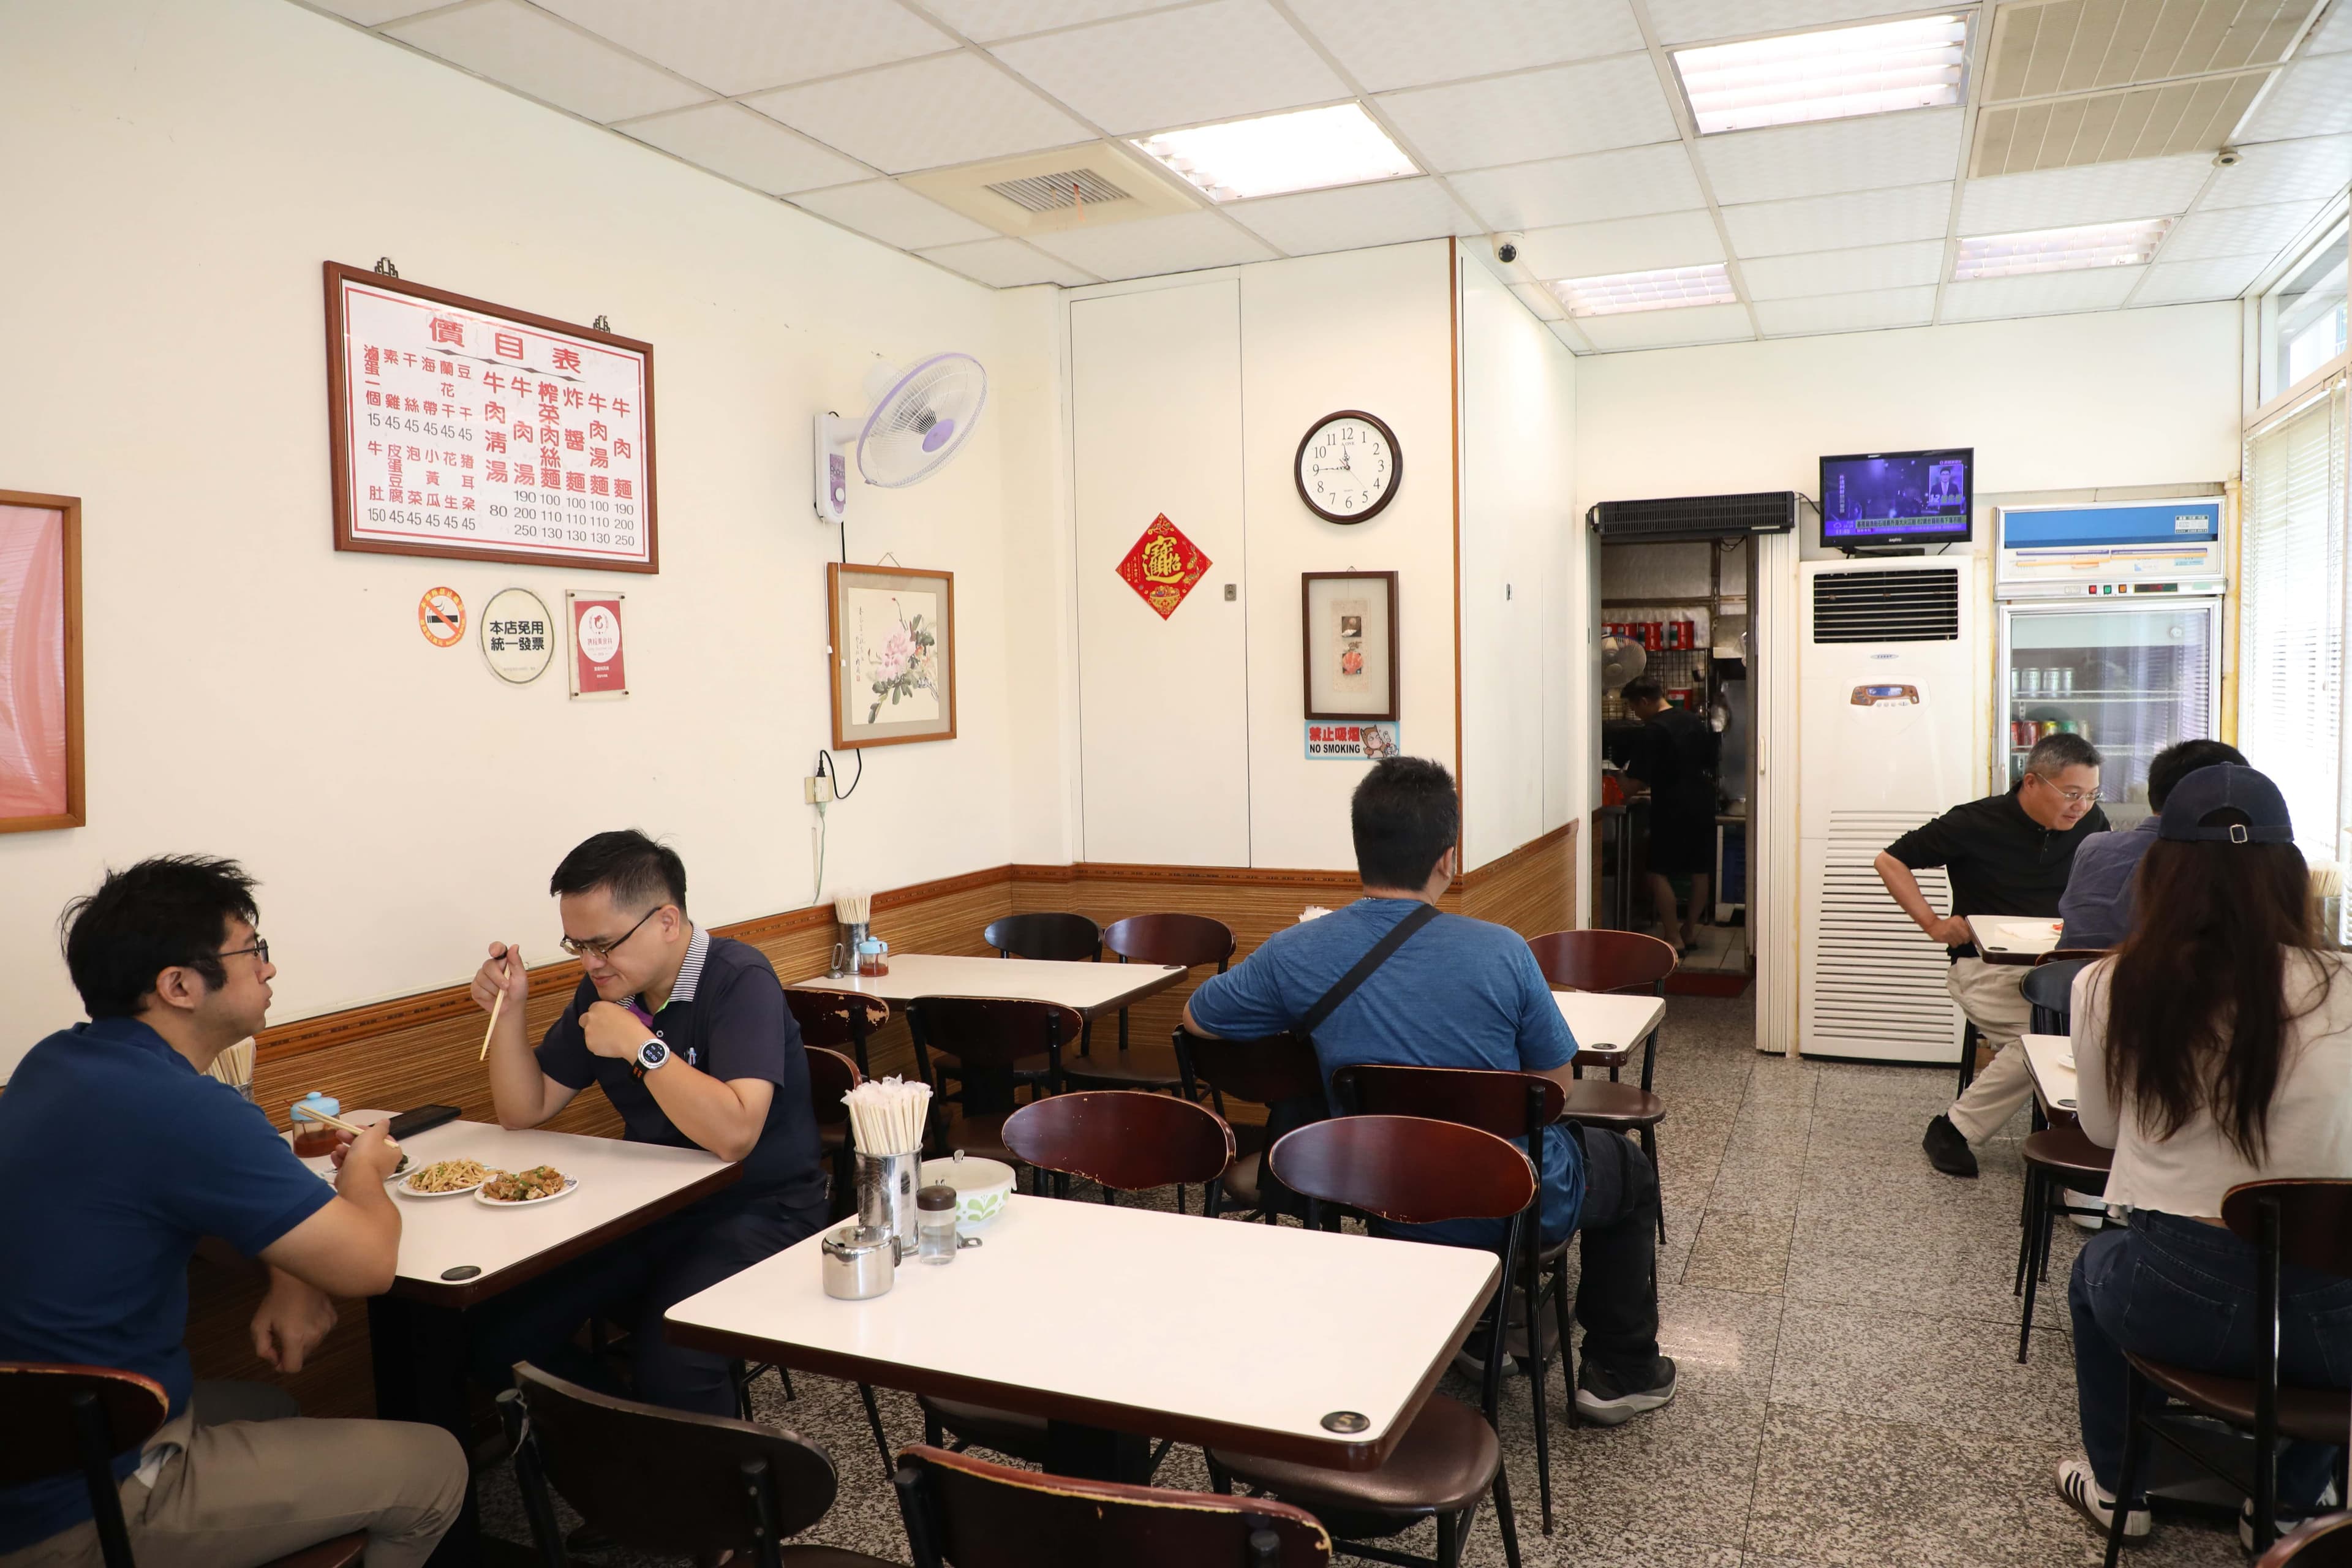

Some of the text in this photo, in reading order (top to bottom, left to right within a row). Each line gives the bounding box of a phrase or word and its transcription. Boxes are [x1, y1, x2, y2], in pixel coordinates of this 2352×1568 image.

[429, 317, 581, 374] 價目表
[364, 344, 381, 406] 滷蛋一個
[383, 349, 400, 410] 素雞
[403, 352, 420, 413] 干絲
[421, 356, 437, 415] 海帶
[440, 360, 455, 418] 蘭花干
[458, 364, 473, 421] 豆干
[367, 413, 473, 441] 15 45 45 45 45 45
[483, 371, 508, 483] 牛肉清湯
[511, 376, 535, 486] 牛肉湯
[538, 381, 561, 490] 榨菜肉絲麵
[563, 386, 586, 493] 炸醬麵
[1327, 434, 1336, 446] 11
[1342, 428, 1353, 440] 12
[1362, 431, 1366, 443] 1
[588, 393, 609, 496] 牛肉湯麵
[612, 398, 633, 499] 牛肉麵
[1314, 446, 1326, 458] 10
[1373, 443, 1380, 455] 2
[368, 440, 385, 501] 牛肚
[388, 443, 404, 503] 皮蛋豆腐
[406, 445, 423, 505] 泡菜
[425, 449, 440, 508] 小黃瓜
[1313, 464, 1319, 476] 9
[1378, 460, 1384, 472] 3
[443, 451, 458, 510] 花生
[1317, 481, 1324, 493] 8
[1373, 477, 1380, 489] 4
[514, 491, 634, 515] 190 100 100 100 190
[1330, 492, 1335, 505] 7
[1346, 496, 1352, 508] 6
[1362, 491, 1368, 503] 5
[368, 508, 476, 530] 150 45 45 45 45 45
[489, 505, 634, 530] 80 200 110 110 110 200
[514, 524, 635, 546] 250 130 130 130 250
[489, 620, 544, 635] 本店免用
[491, 637, 545, 651] 統一發票
[1310, 744, 1360, 753] NO SMOKING
